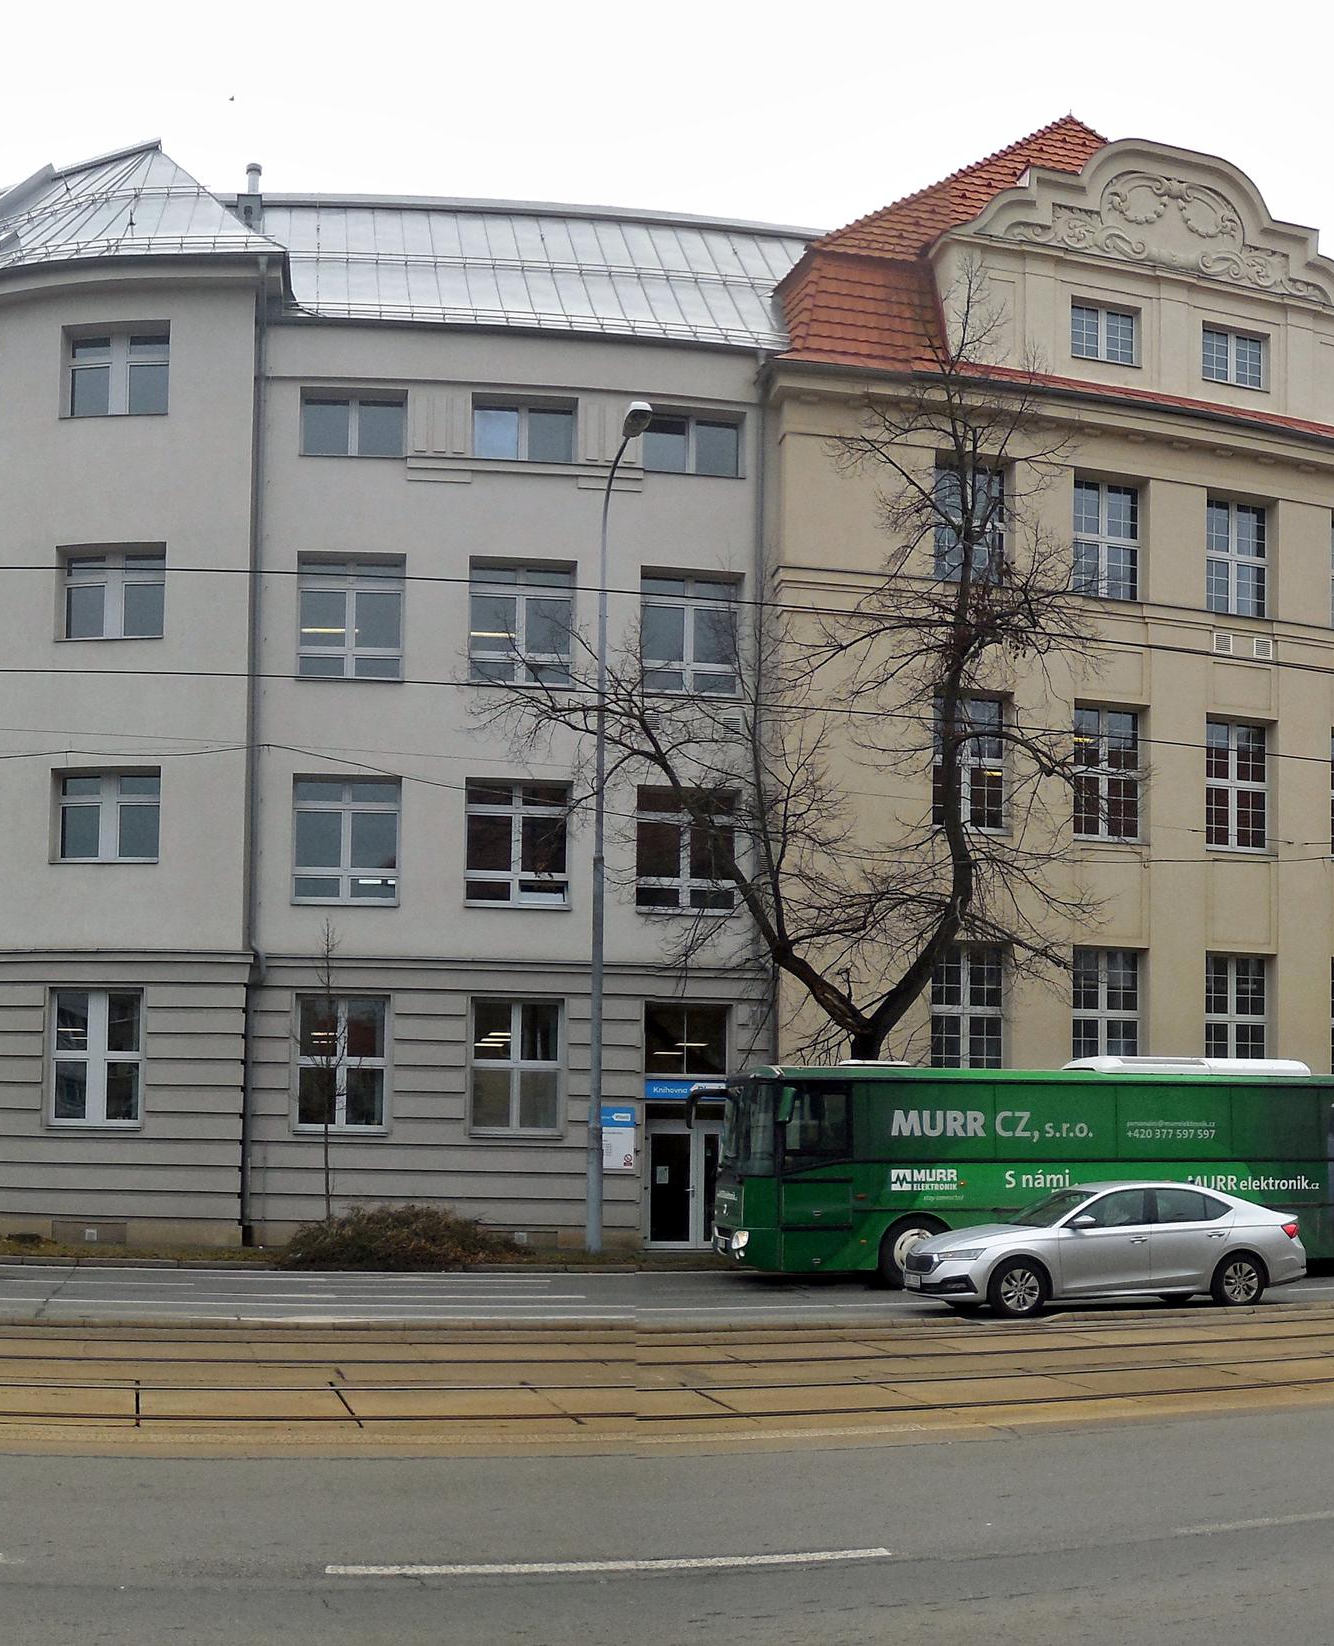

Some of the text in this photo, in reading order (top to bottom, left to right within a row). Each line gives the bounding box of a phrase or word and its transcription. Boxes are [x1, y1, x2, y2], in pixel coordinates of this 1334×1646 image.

[653, 1086, 688, 1094] Knihovna
[890, 1109, 1093, 1142] MURR CZ, s.r.o.
[1127, 1129, 1216, 1139] +420 377 597 597
[913, 1169, 957, 1181] MURR
[1005, 1169, 1070, 1188] S námi
[913, 1183, 958, 1191] ELEKTRONIK
